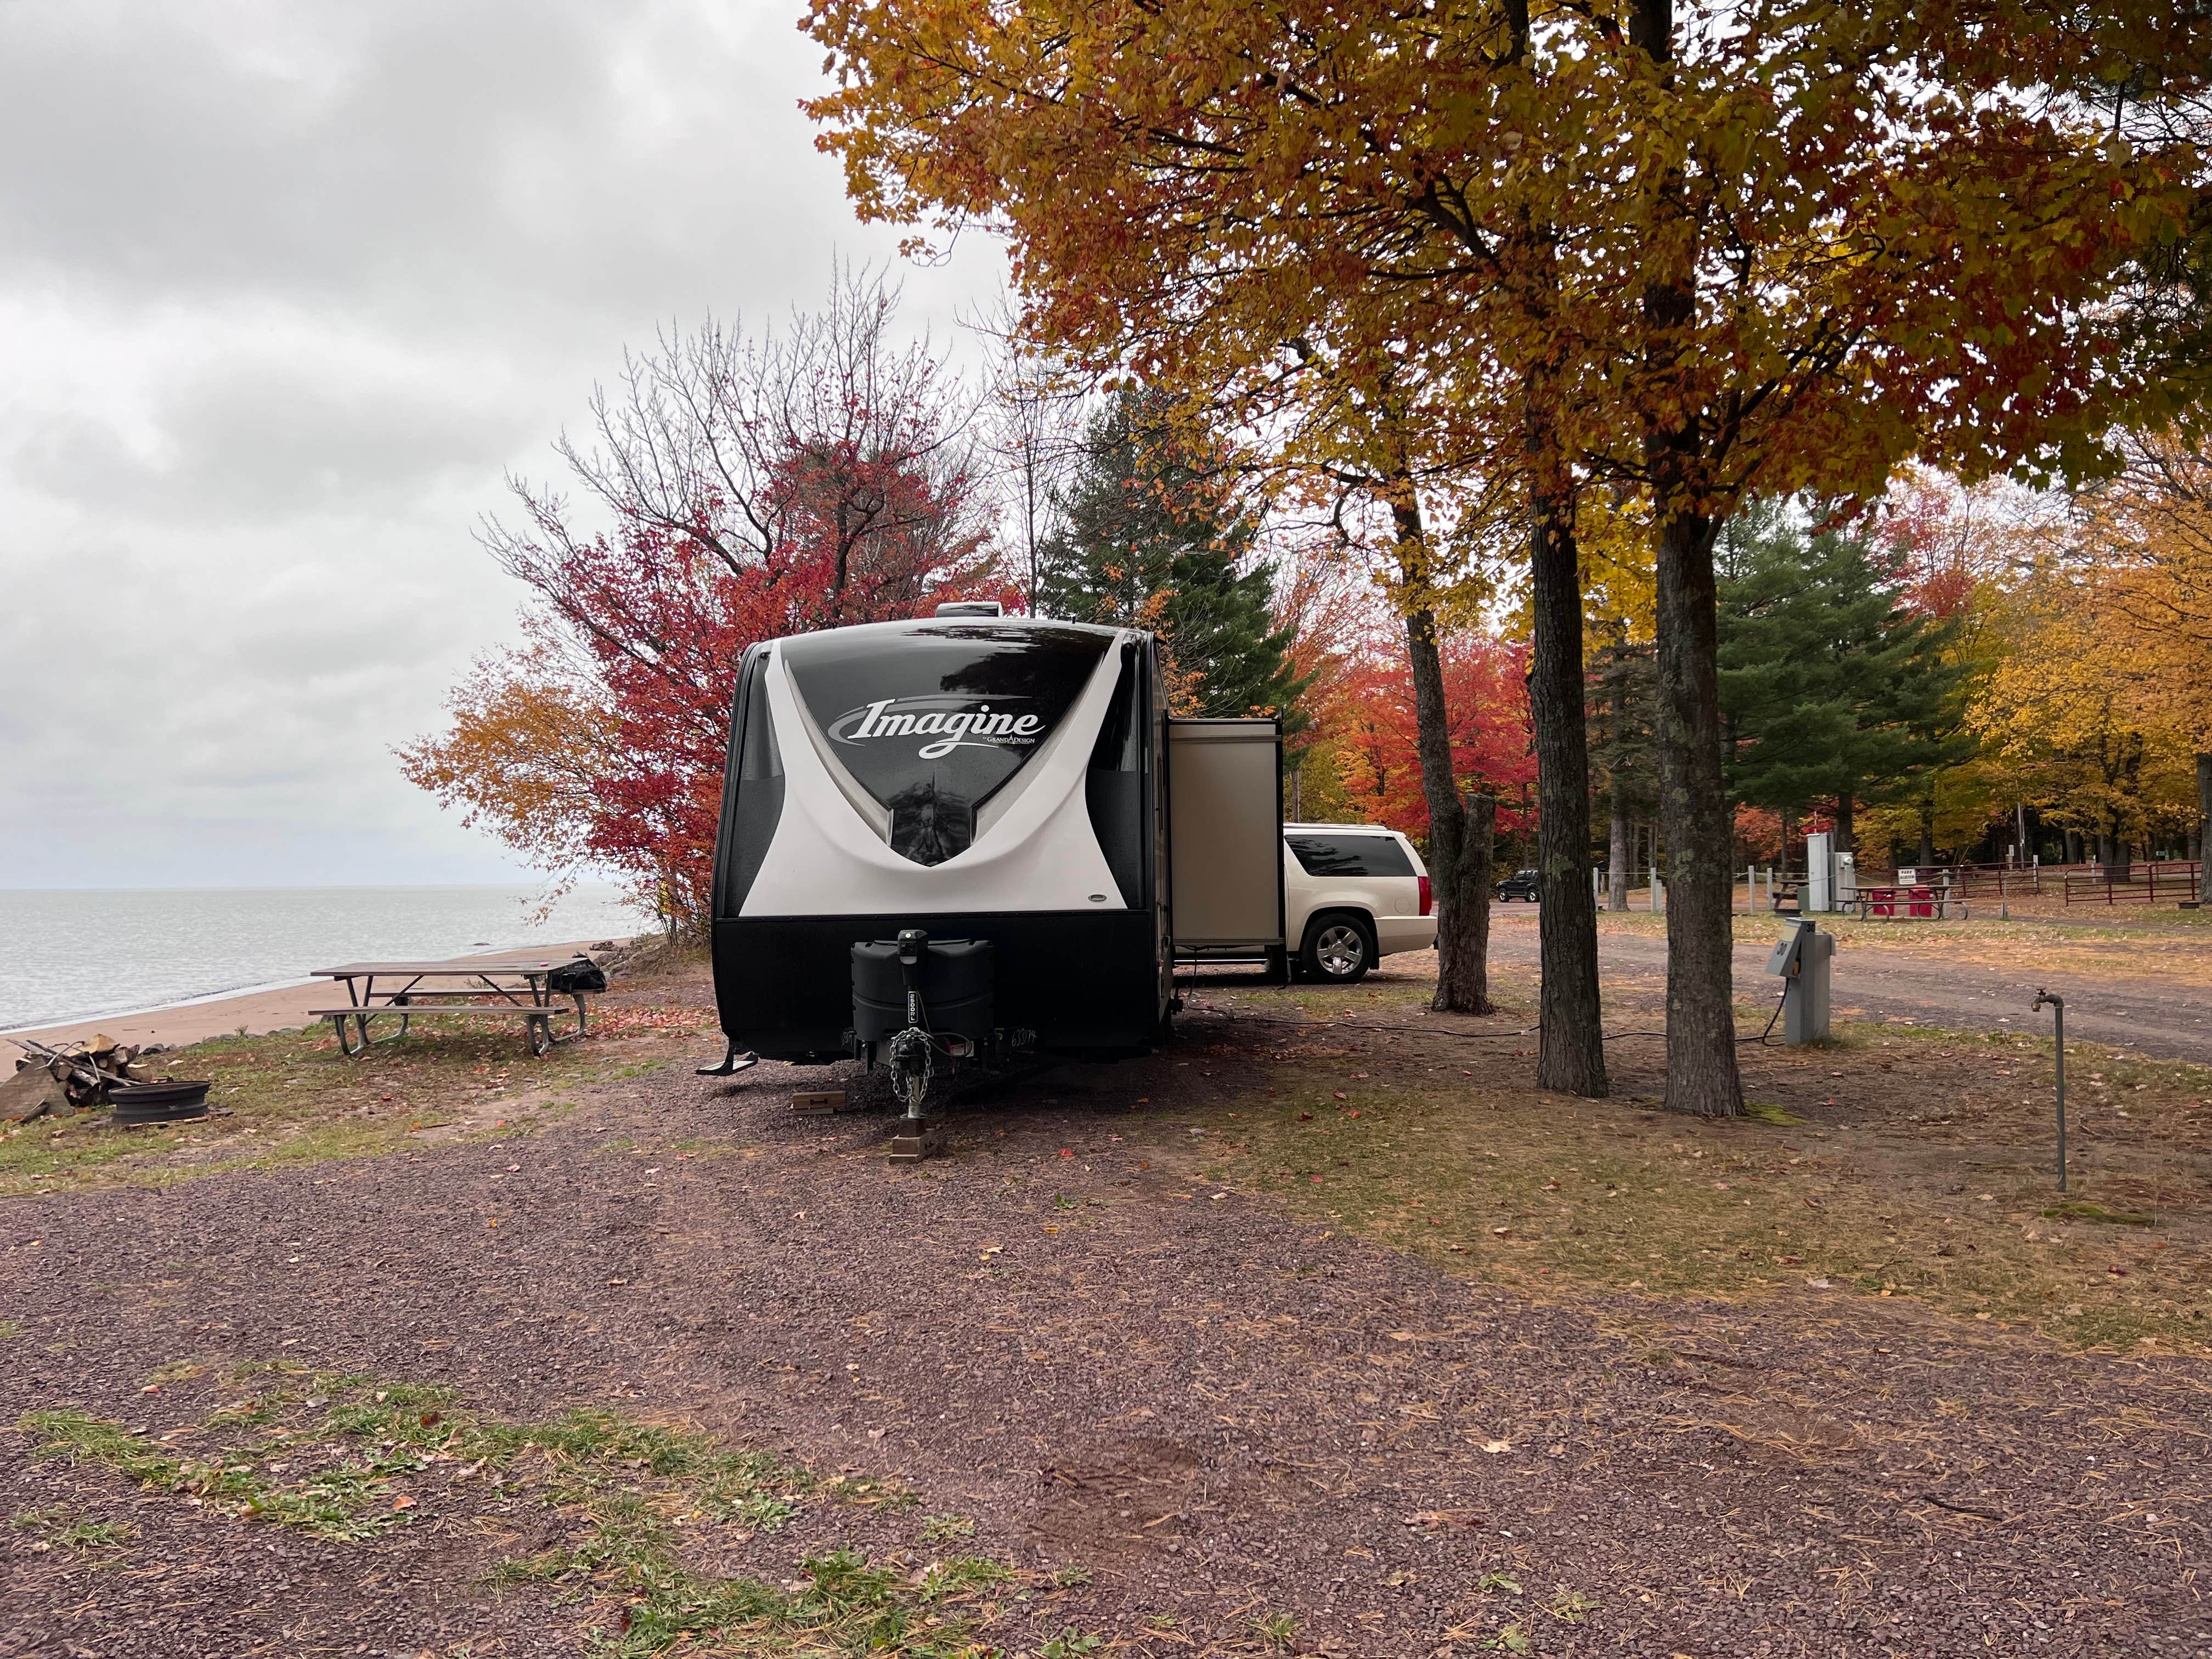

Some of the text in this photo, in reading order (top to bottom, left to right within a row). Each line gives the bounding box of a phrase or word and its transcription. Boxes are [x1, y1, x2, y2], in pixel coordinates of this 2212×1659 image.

[848, 698, 1046, 759] Imagine
[1806, 923, 1816, 933] 30
[1776, 942, 1787, 956] 30
